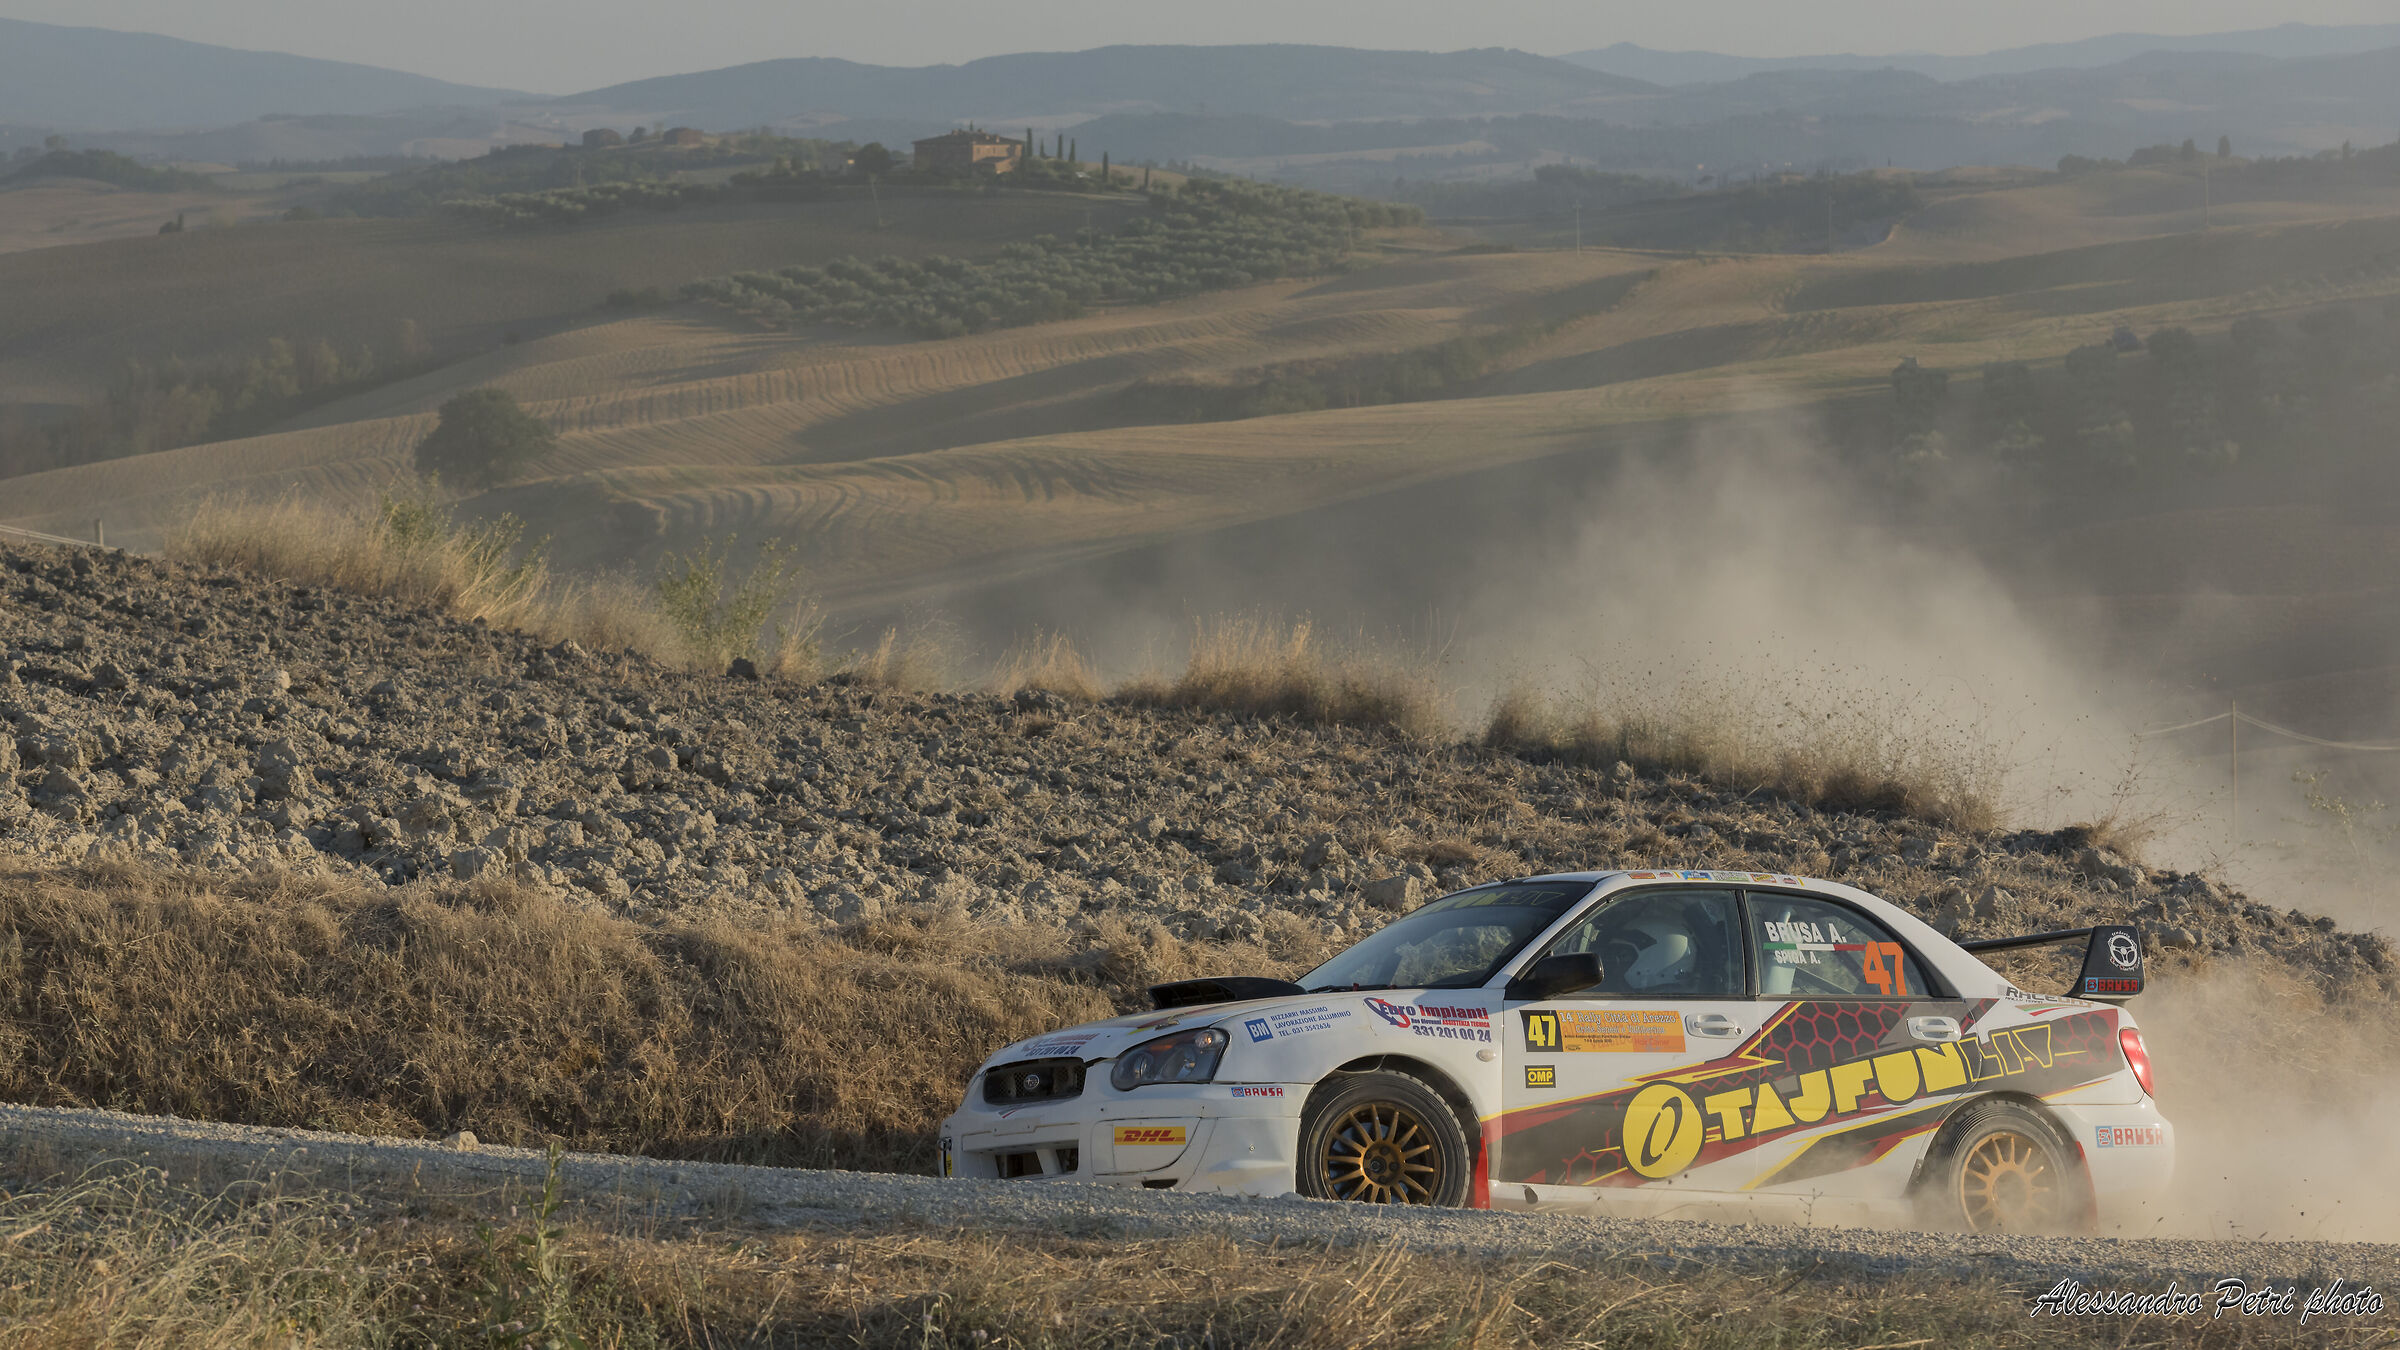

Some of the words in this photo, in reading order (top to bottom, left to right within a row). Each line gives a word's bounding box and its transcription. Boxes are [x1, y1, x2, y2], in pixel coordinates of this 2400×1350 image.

[1764, 921, 1825, 943] BRUSA
[1828, 922, 1848, 943] A.
[1810, 951, 1821, 964] A.
[1863, 940, 1907, 996] 47
[1270, 1011, 1299, 1021] BIZZARRI
[1300, 1006, 1328, 1016] MASSIMO
[1274, 1017, 1317, 1029] LAVORAZIONE
[1318, 1010, 1352, 1021] ALLUMINIO
[1418, 1004, 1489, 1020] Impianti
[1576, 1012, 1600, 1024] Rally
[1604, 1012, 1628, 1023] Città
[1630, 1012, 1640, 1023] di
[1643, 1012, 1676, 1023] Arezzo
[1249, 1022, 1270, 1038] BM
[1292, 1026, 1304, 1034] 031
[1412, 1025, 1436, 1037] 331
[1436, 1027, 1458, 1039] 201
[1459, 1028, 1476, 1041] 00
[1477, 1029, 1492, 1043] 24
[1528, 1015, 1556, 1046] 47
[1528, 1071, 1553, 1082] OMP
[1123, 1130, 1176, 1142] DHL
